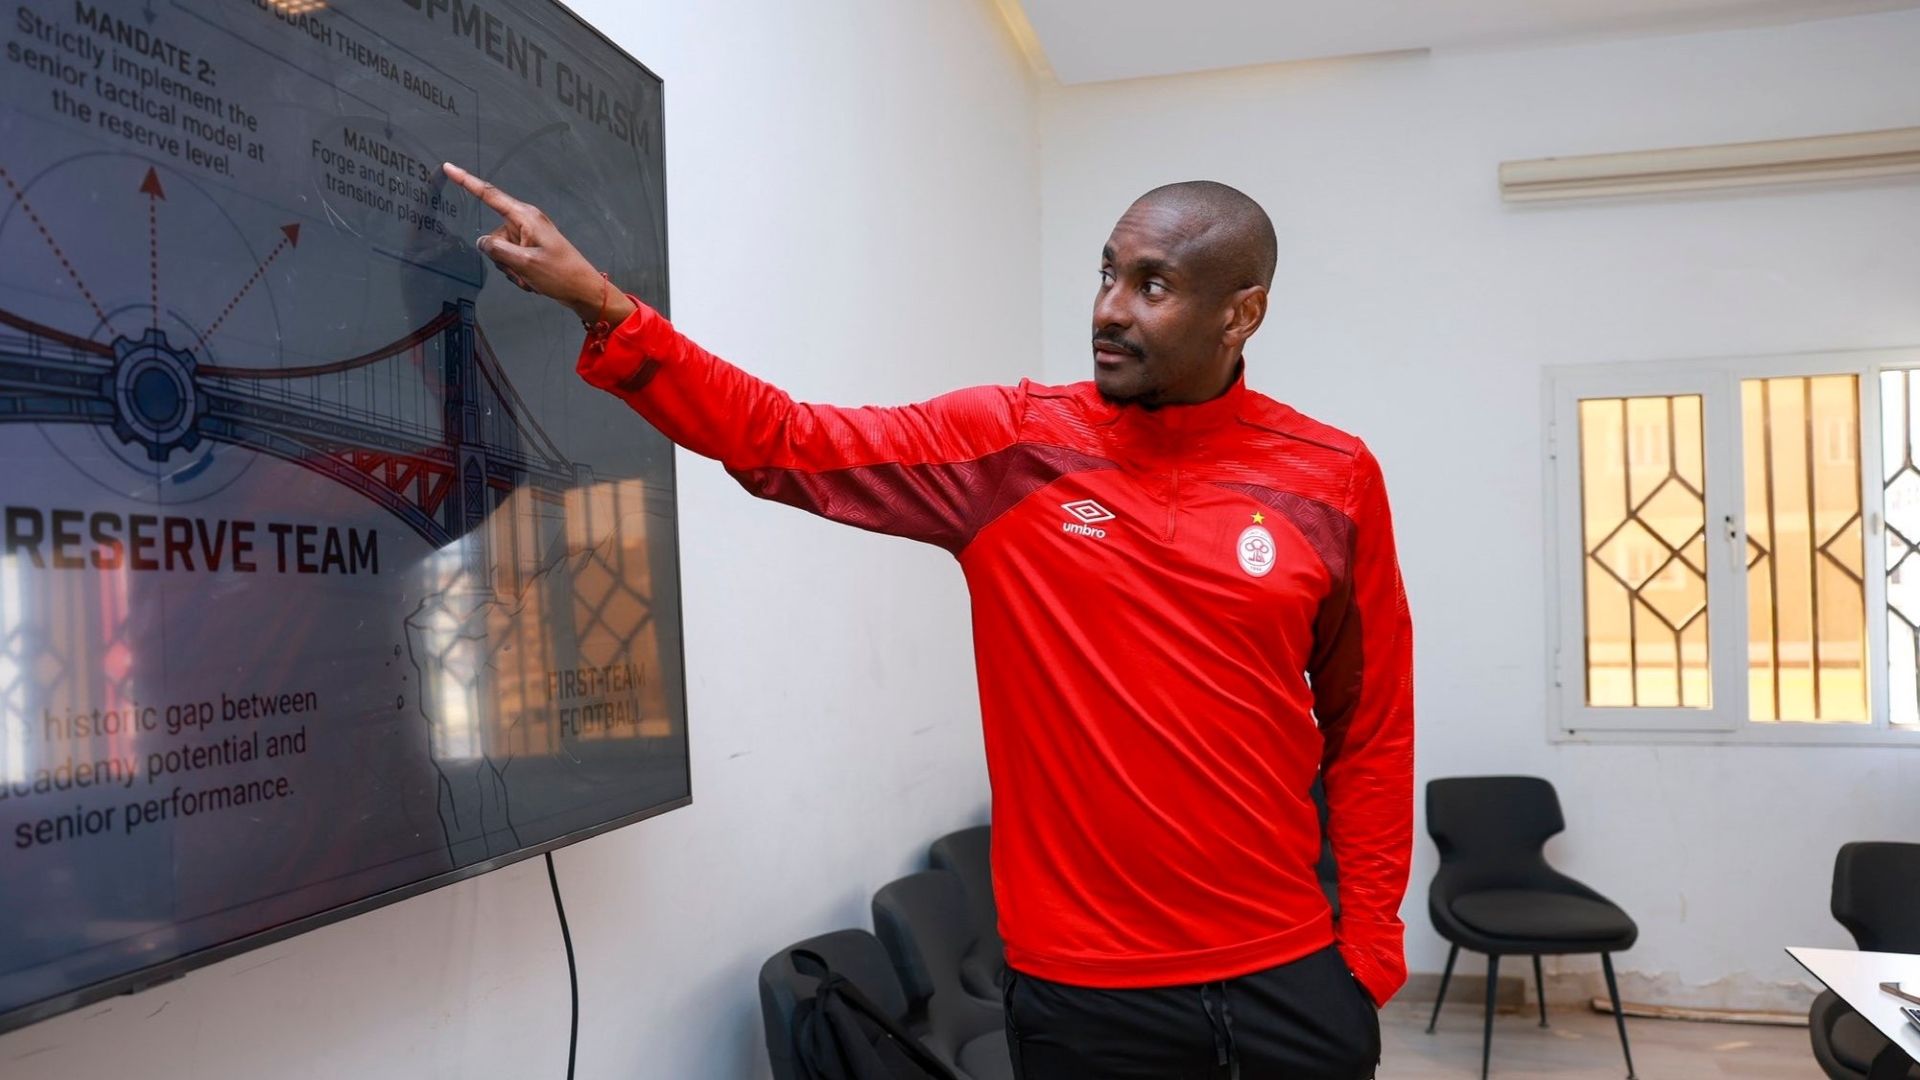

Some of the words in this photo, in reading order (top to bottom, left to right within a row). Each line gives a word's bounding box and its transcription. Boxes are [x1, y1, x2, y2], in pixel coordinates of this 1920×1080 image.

[17, 6, 106, 69] Strictly
[112, 48, 222, 118] implement
[229, 104, 257, 132] the
[75, 0, 191, 76] MANDATE
[197, 59, 216, 87] 2:
[336, 31, 399, 85] THEMBA
[404, 74, 459, 116] BADELA.
[402, 0, 548, 88] PMENT
[556, 62, 651, 156] CHASM
[7, 41, 88, 86] senior
[95, 76, 176, 125] tactical
[182, 115, 242, 153] model
[247, 142, 264, 163] at
[52, 89, 92, 123] the
[100, 110, 179, 157] reserve
[186, 140, 235, 178] level.
[312, 139, 355, 174] Forge
[359, 164, 385, 188] and
[389, 178, 428, 206] polish
[431, 193, 457, 219] elite
[344, 127, 415, 177] MANDATE
[419, 163, 432, 185] 3:
[326, 173, 394, 215] transition
[5, 505, 257, 573] RESERVE
[268, 521, 380, 576] TEAM
[1062, 521, 1106, 540] umbro
[44, 702, 157, 741] historic
[166, 702, 213, 735] gap
[221, 691, 318, 724] between
[547, 662, 646, 700] FIRST-TEAM
[147, 732, 258, 783] potential
[266, 726, 307, 759] and
[560, 699, 643, 738] FOOTBALL
[14, 804, 117, 849] senior
[124, 774, 294, 834] performance.
